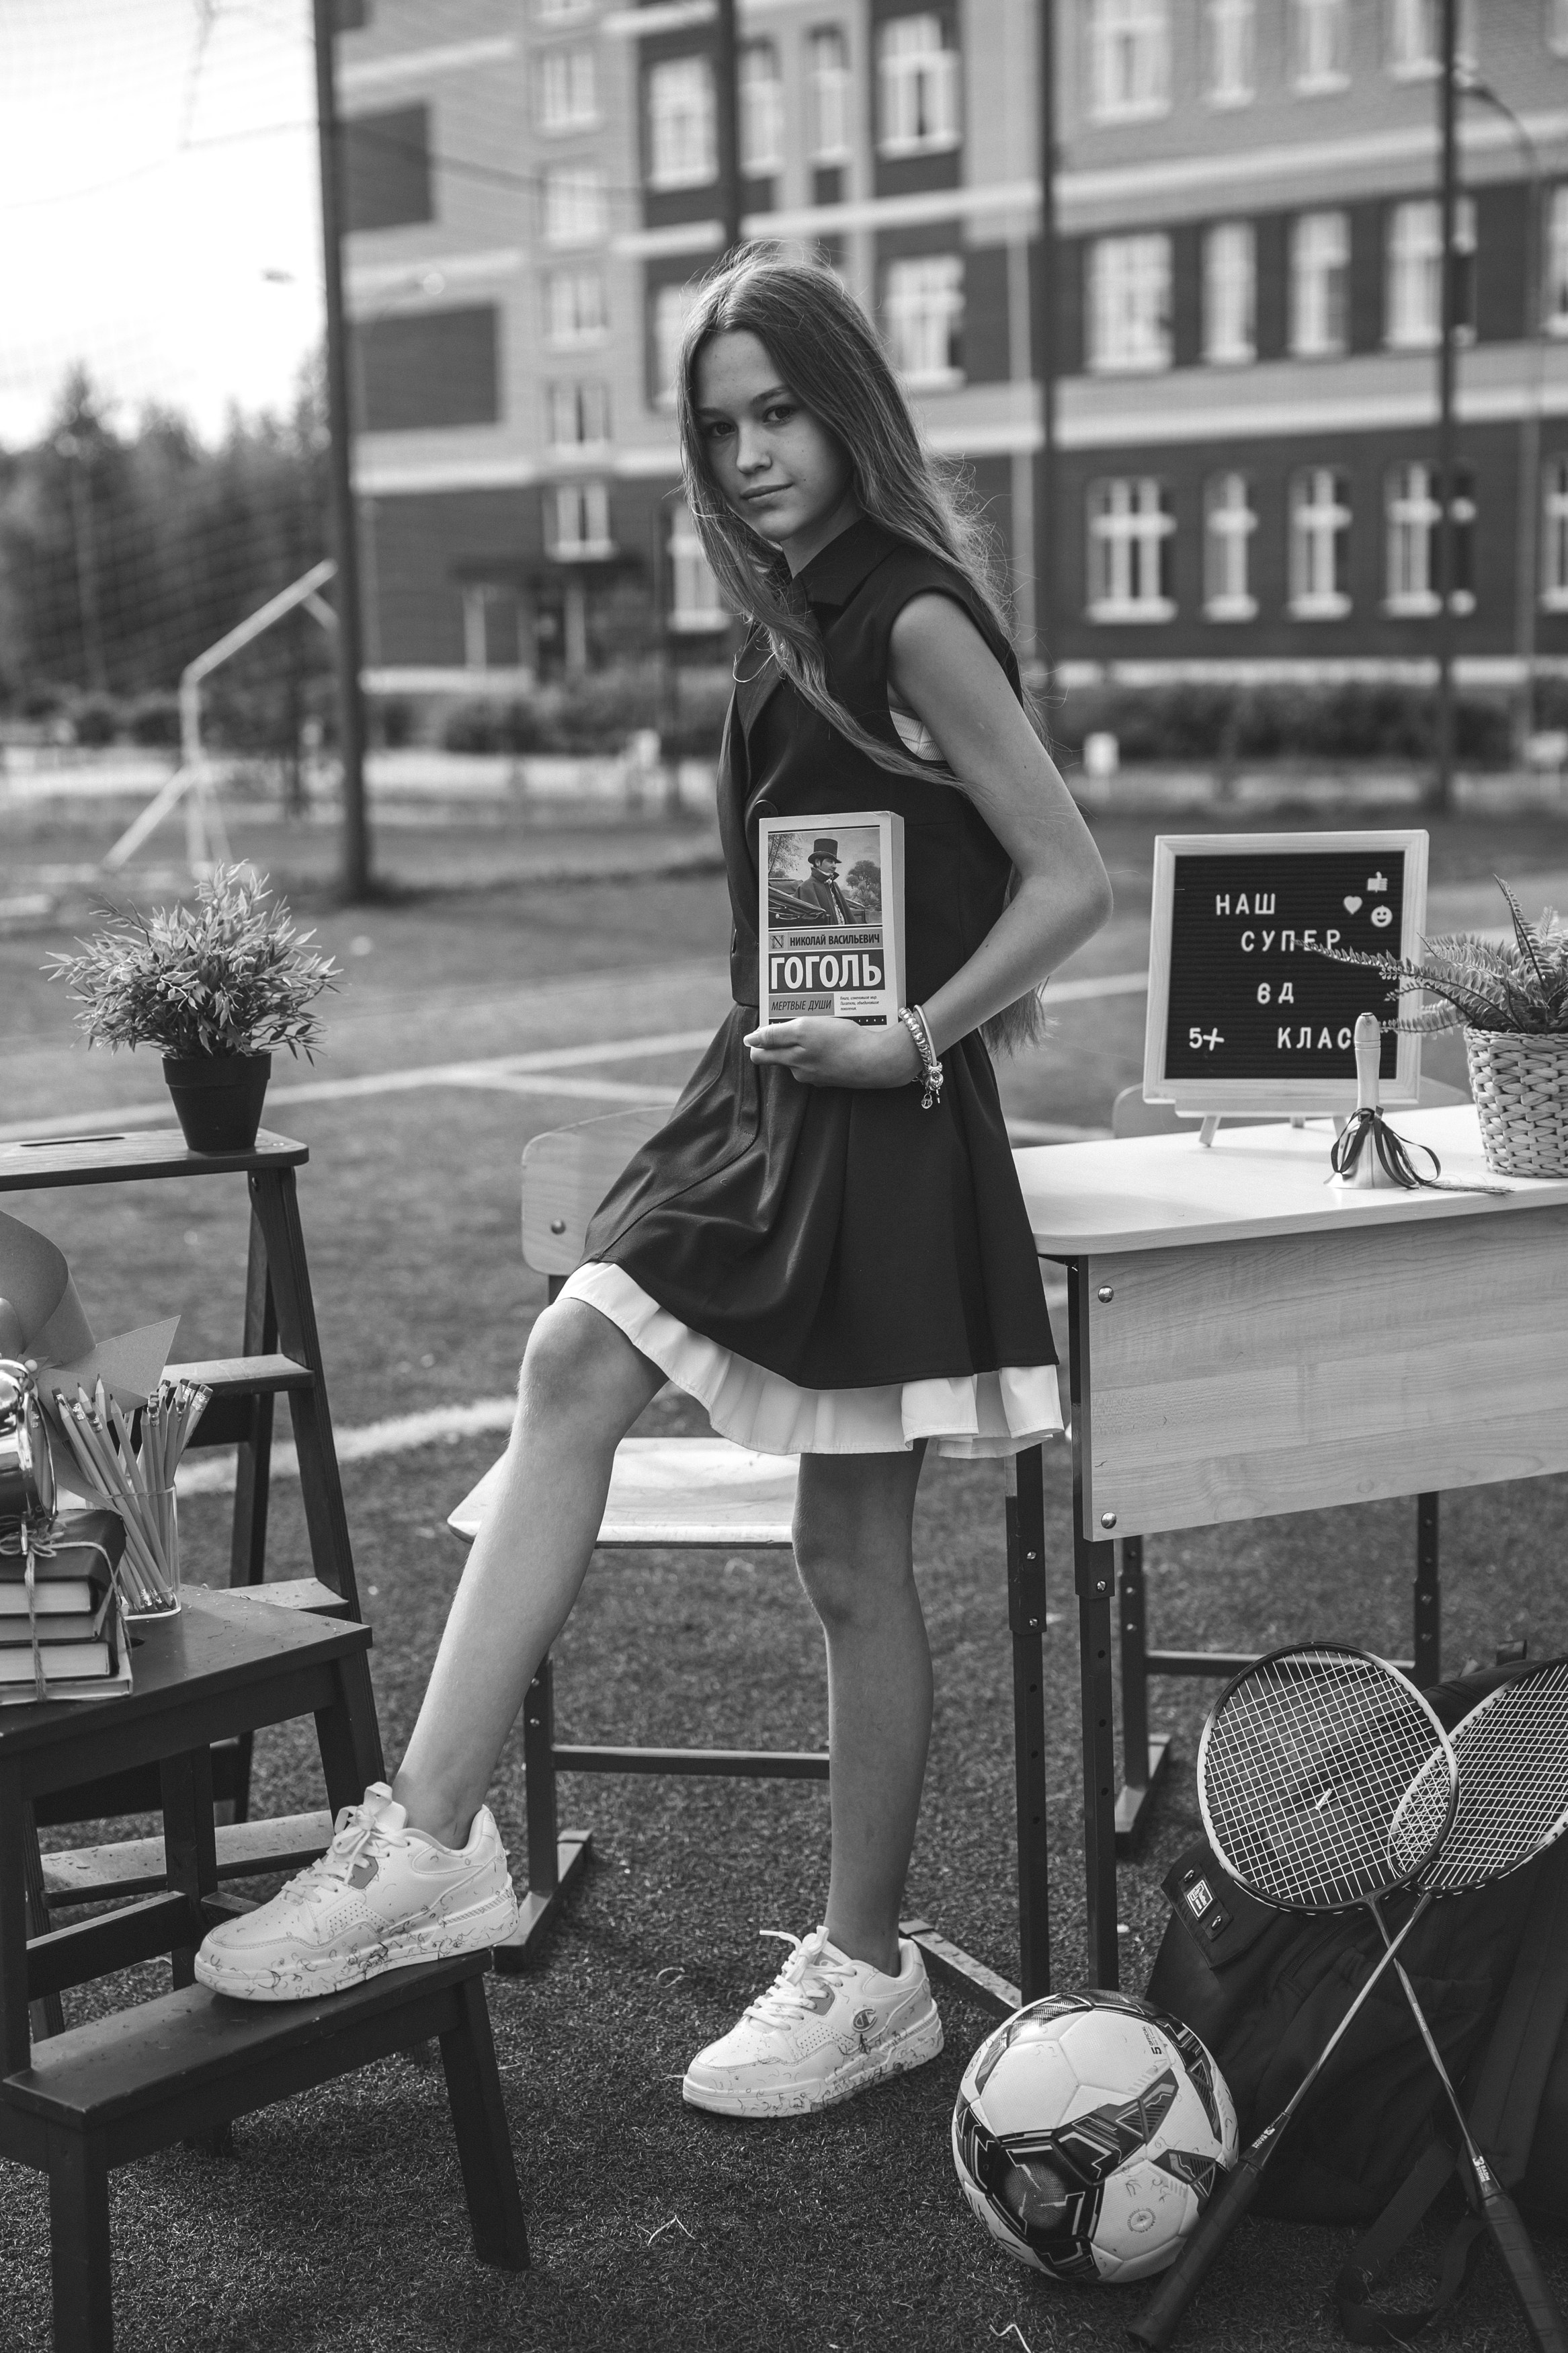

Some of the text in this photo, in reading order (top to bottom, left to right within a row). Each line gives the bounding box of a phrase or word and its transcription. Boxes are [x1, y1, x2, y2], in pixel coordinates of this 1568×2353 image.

[1216, 893, 1276, 916] НАШ
[790, 933, 880, 947] НИКОЛАЙ ВАСИЛЬЕВИЧ
[1241, 929, 1341, 952] СУПЕР
[771, 954, 882, 990] ГОГОЛЬ
[771, 999, 832, 1011] МЕРТВЫЕ ДУШИ
[1189, 1027, 1225, 1051] 5+
[1278, 1027, 1352, 1049] КЛАС
[1151, 2046, 1162, 2055] 5
[1481, 2165, 1491, 2182] BADM
